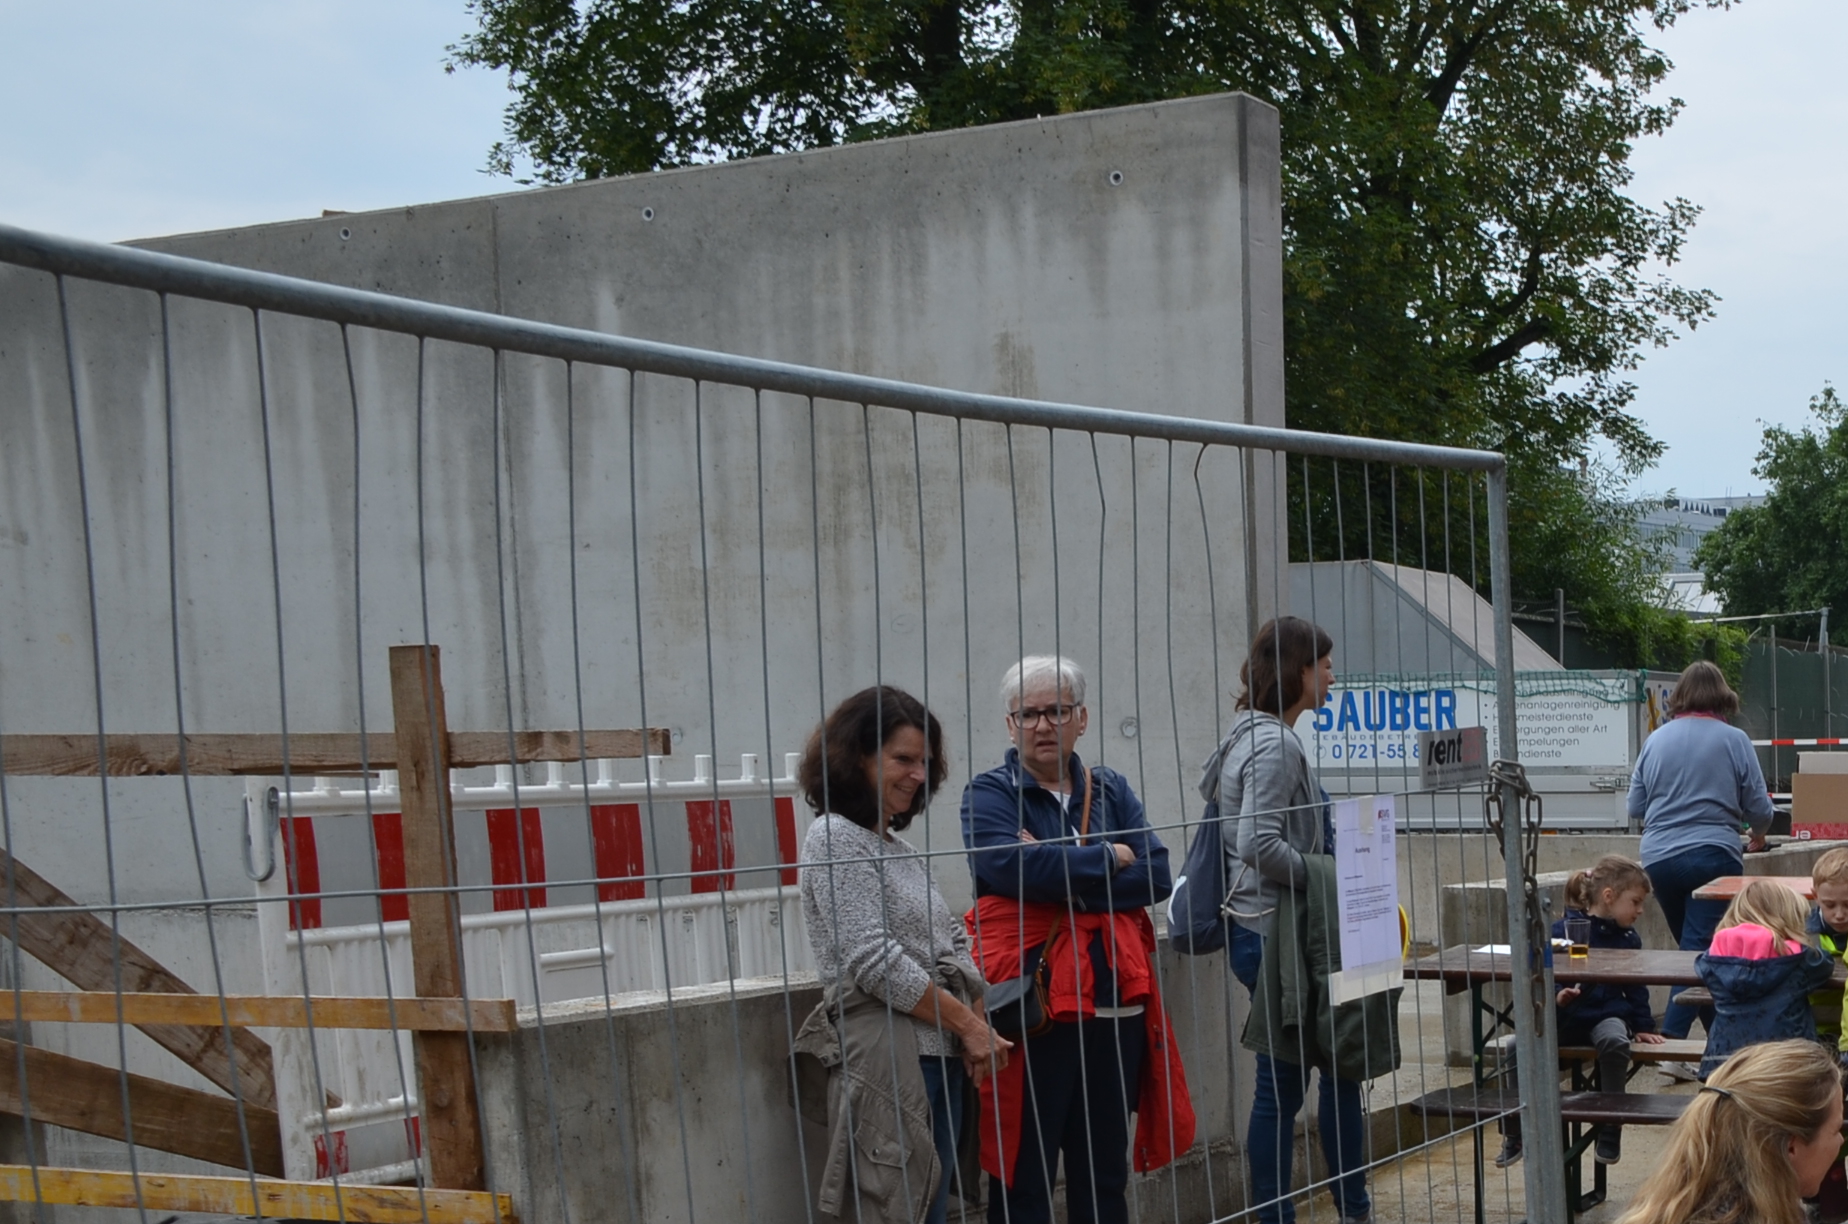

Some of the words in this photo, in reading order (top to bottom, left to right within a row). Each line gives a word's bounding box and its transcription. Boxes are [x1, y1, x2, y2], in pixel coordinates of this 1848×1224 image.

[1312, 690, 1457, 732] SAUBER
[1567, 724, 1590, 734] aller
[1592, 724, 1608, 733] Art
